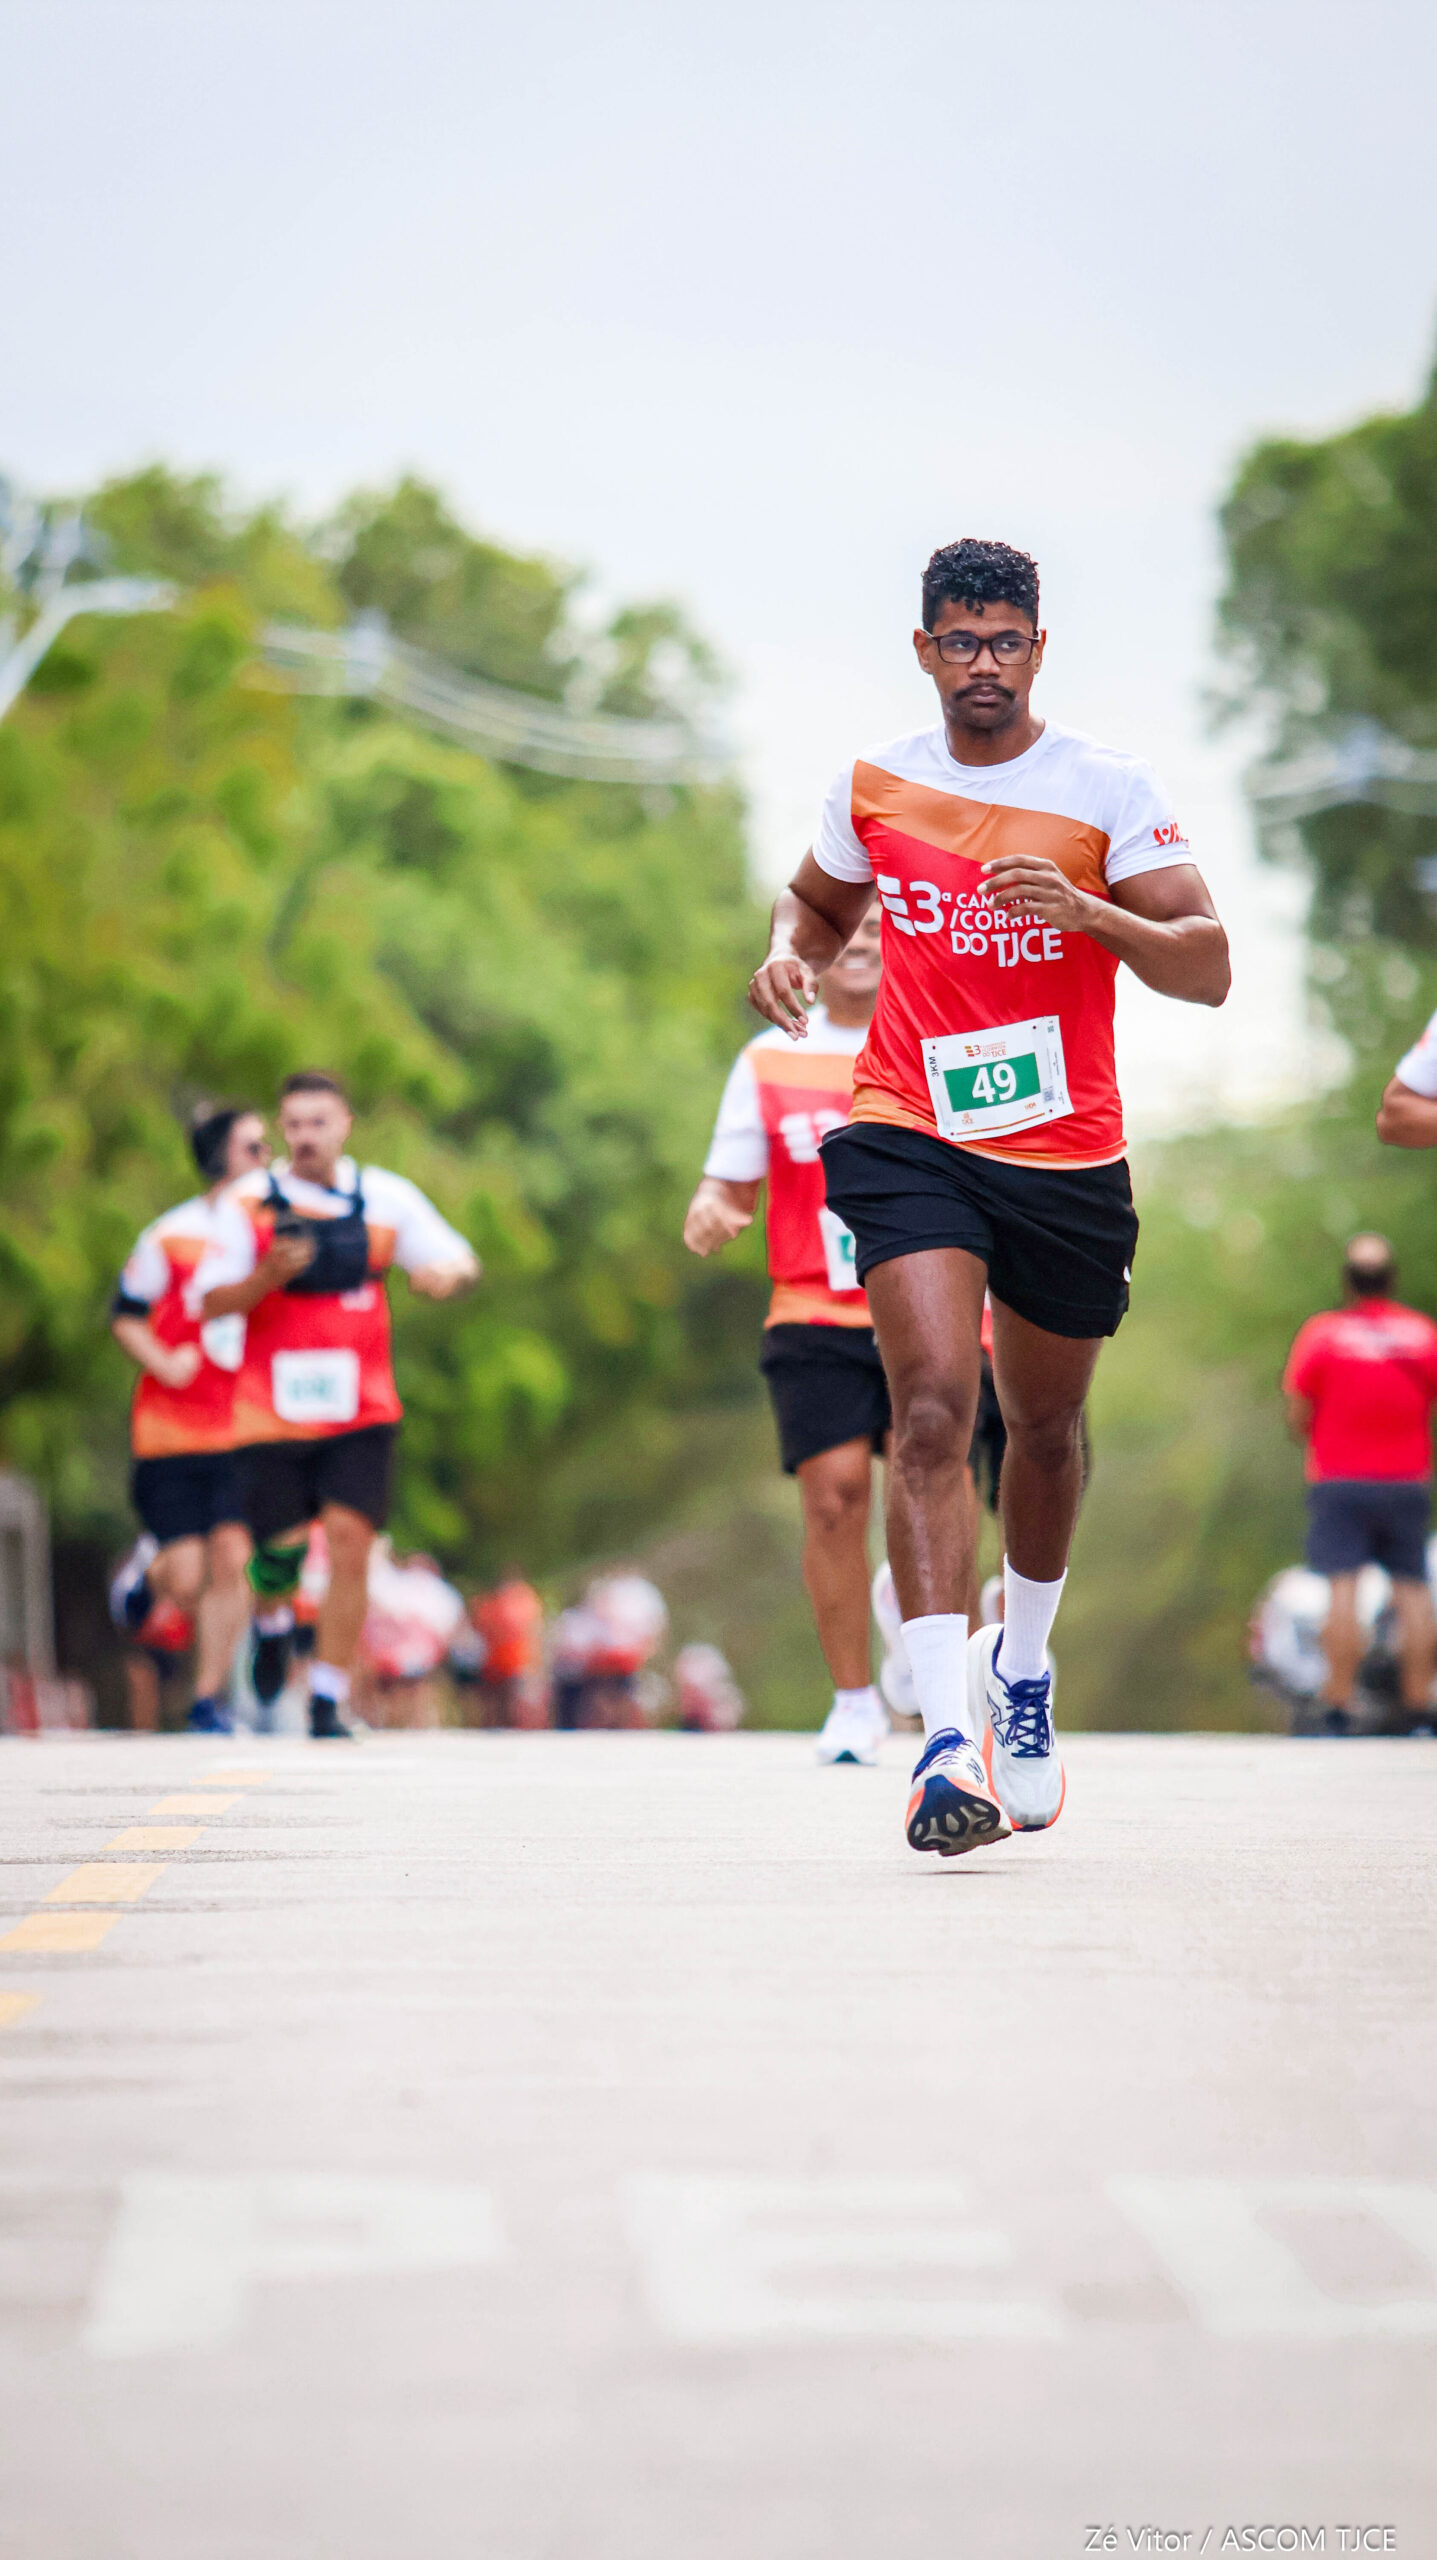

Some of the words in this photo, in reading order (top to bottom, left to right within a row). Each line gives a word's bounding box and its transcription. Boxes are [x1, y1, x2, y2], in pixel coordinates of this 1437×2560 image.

[951, 930, 988, 956] DO
[991, 928, 1064, 968] TJCE
[928, 1056, 940, 1077] 3KM
[971, 1062, 1017, 1104] 49
